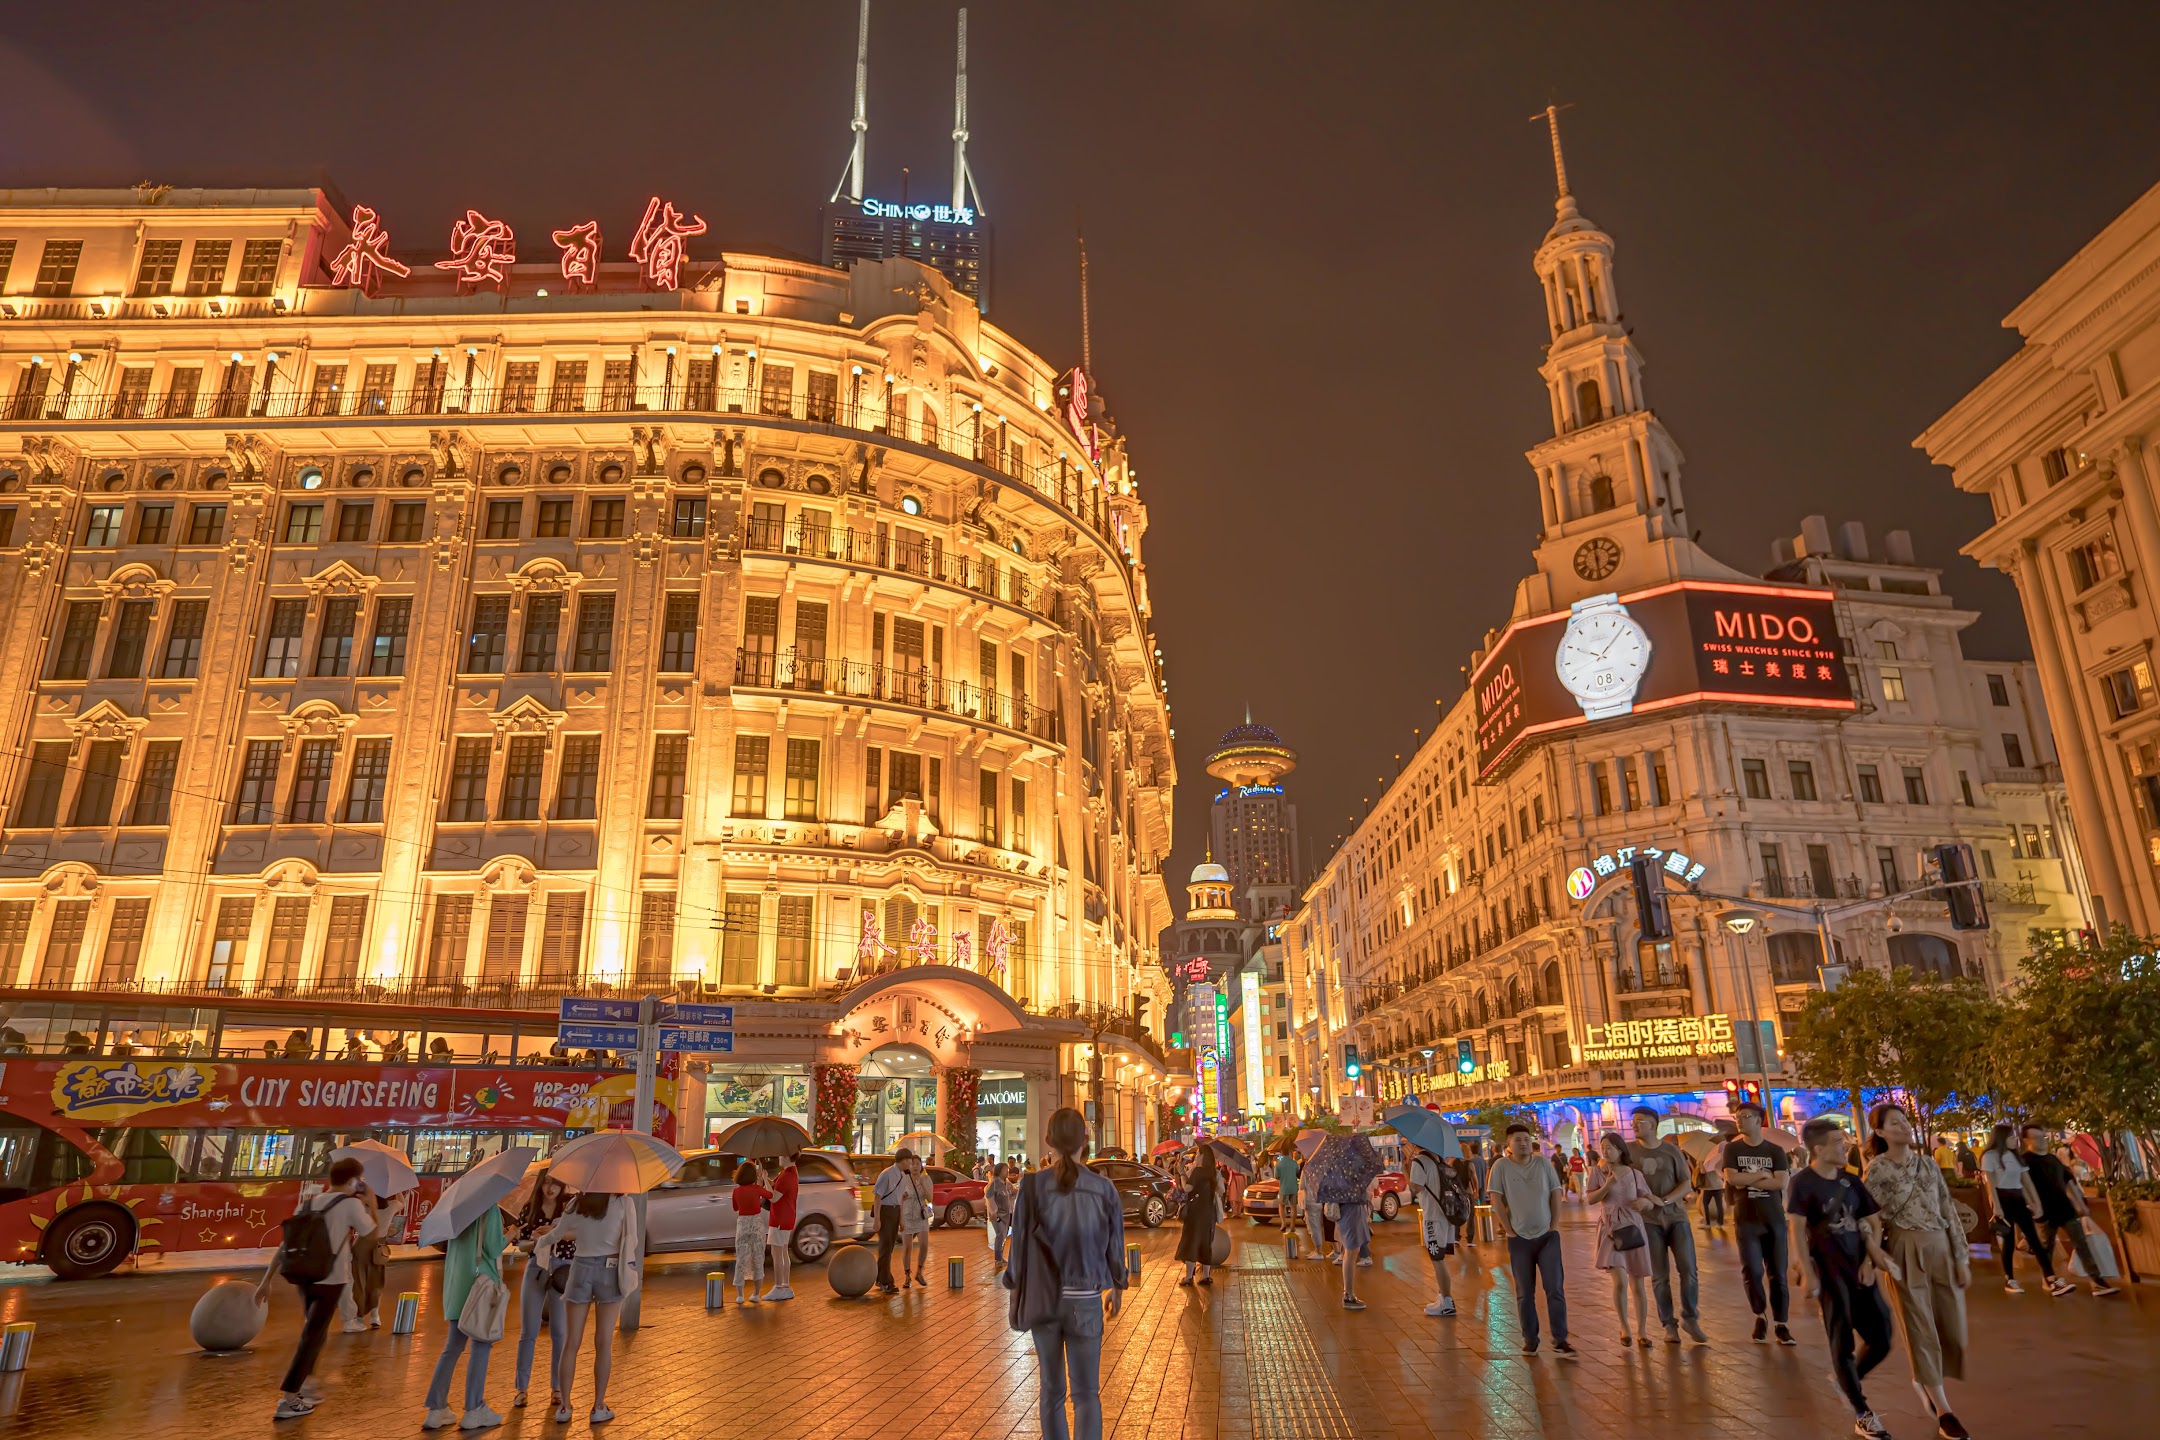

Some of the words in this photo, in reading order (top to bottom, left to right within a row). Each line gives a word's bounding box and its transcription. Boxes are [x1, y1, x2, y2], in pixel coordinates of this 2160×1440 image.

[932, 204, 974, 226] 世茂
[1703, 643, 1732, 652] SWISS
[1735, 645, 1778, 656] WATCHES
[1782, 649, 1812, 658] SINCE
[1814, 651, 1835, 659] 1918
[1713, 657, 1833, 680] 瑞士美度表
[1596, 672, 1613, 686] 08
[594, 1032, 636, 1044] 上海书城
[679, 1030, 710, 1043] 中国邮政
[1583, 1013, 1732, 1049] 上海时装商店
[1583, 1049, 1639, 1061] SHANGHAI
[1642, 1045, 1691, 1058] FASHION
[1695, 1041, 1735, 1054] STORE
[1486, 1060, 1511, 1080] STORE
[240, 1076, 290, 1107] CITY
[298, 1078, 438, 1108] SIGHTSEEING
[533, 1081, 589, 1095] HOP-ON
[532, 1096, 598, 1109] HOP-OFF
[977, 1090, 1026, 1106] LANCÔME
[180, 1202, 245, 1223] Shanghai
